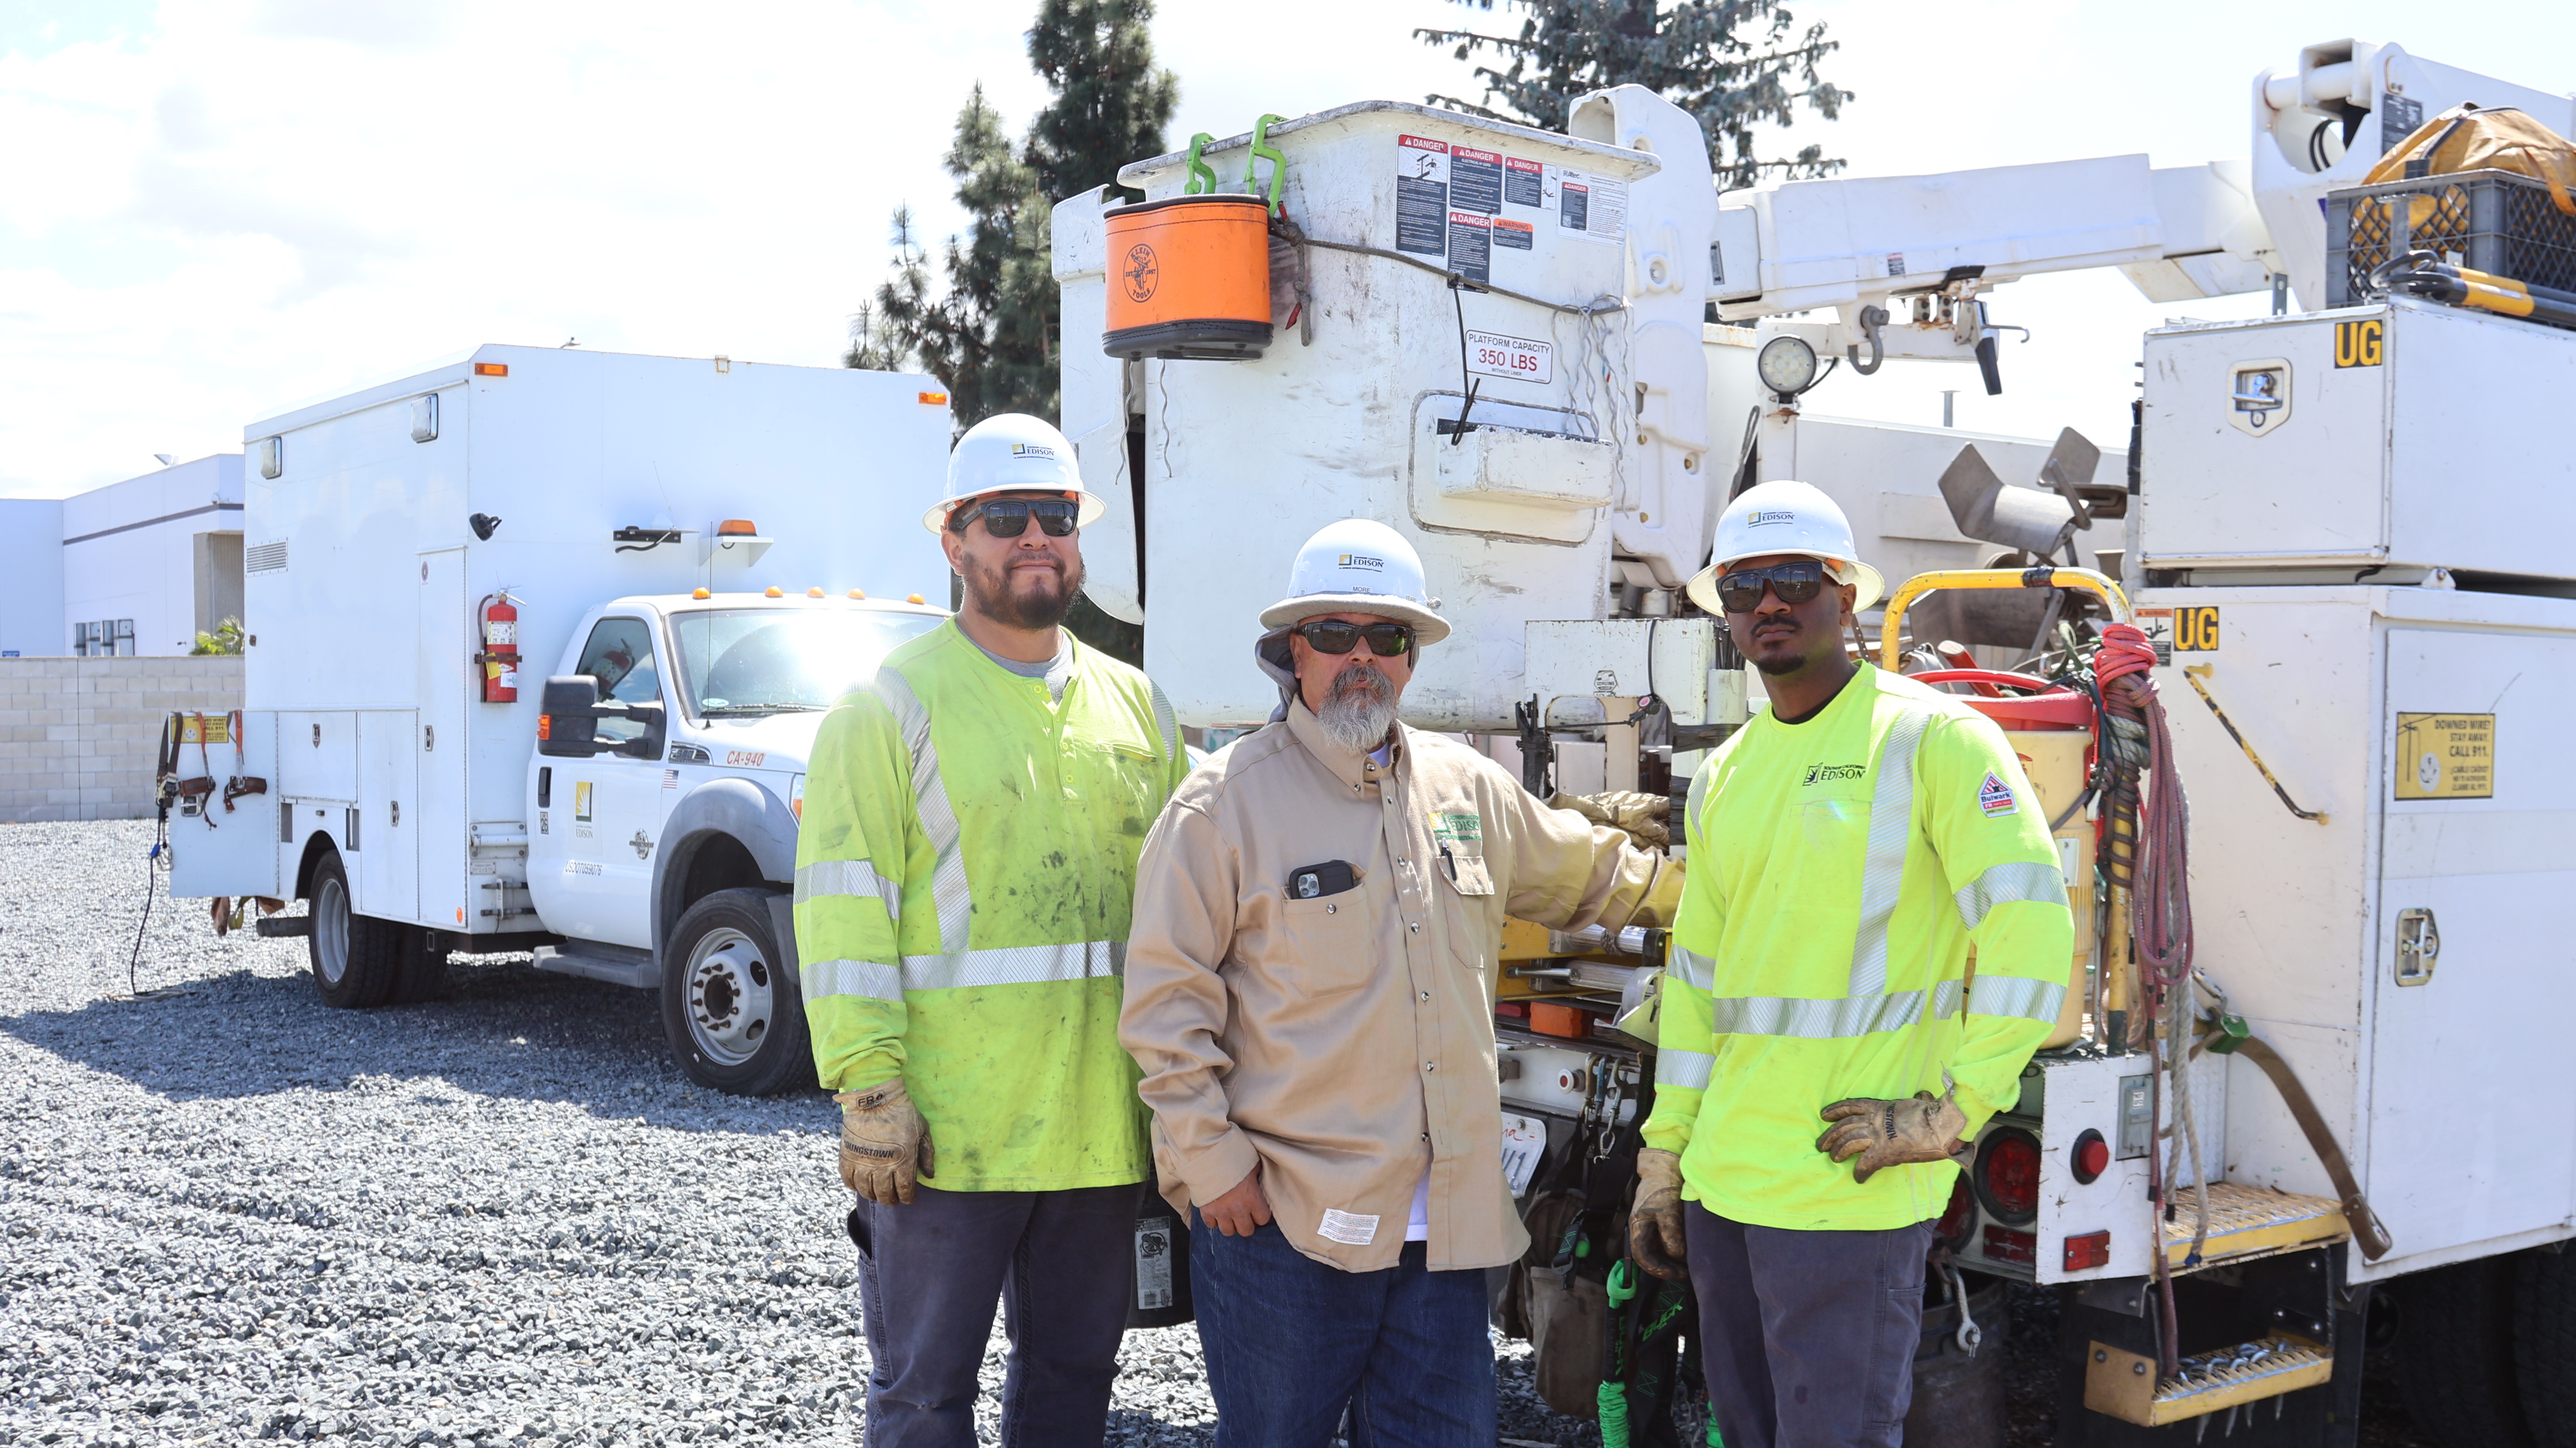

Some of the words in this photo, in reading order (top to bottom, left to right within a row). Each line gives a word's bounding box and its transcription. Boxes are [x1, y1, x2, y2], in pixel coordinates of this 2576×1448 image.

[1413, 138, 1444, 151] DANGER
[1465, 149, 1494, 162] DANGER
[1514, 160, 1538, 171] DANGER
[1458, 215, 1490, 227] DANGER
[1502, 220, 1529, 231] WARNING
[1130, 247, 1150, 260] KLEIN
[1133, 288, 1150, 299] TOOLS
[1468, 334, 1510, 348] PLATFORM
[1512, 341, 1550, 354] CAPACITY
[2335, 321, 2382, 367] UG
[1478, 348, 1506, 366] 350
[1510, 352, 1538, 372] LBS
[1353, 559, 1384, 568] EDISON
[2174, 607, 2218, 650] UG
[2435, 719, 2467, 730] DOWNED
[2449, 745, 2470, 757] CALL
[727, 750, 765, 767] CA-940
[1820, 769, 1865, 780] EDISON
[1980, 792, 2011, 802] Bulwark
[541, 818, 548, 832] 26
[1450, 820, 1480, 831] EDISO
[576, 828, 594, 839] EDISON
[565, 860, 603, 877] USDOT059076
[858, 1095, 874, 1107] FR
[844, 1139, 895, 1159] YOUNGSTOWN
